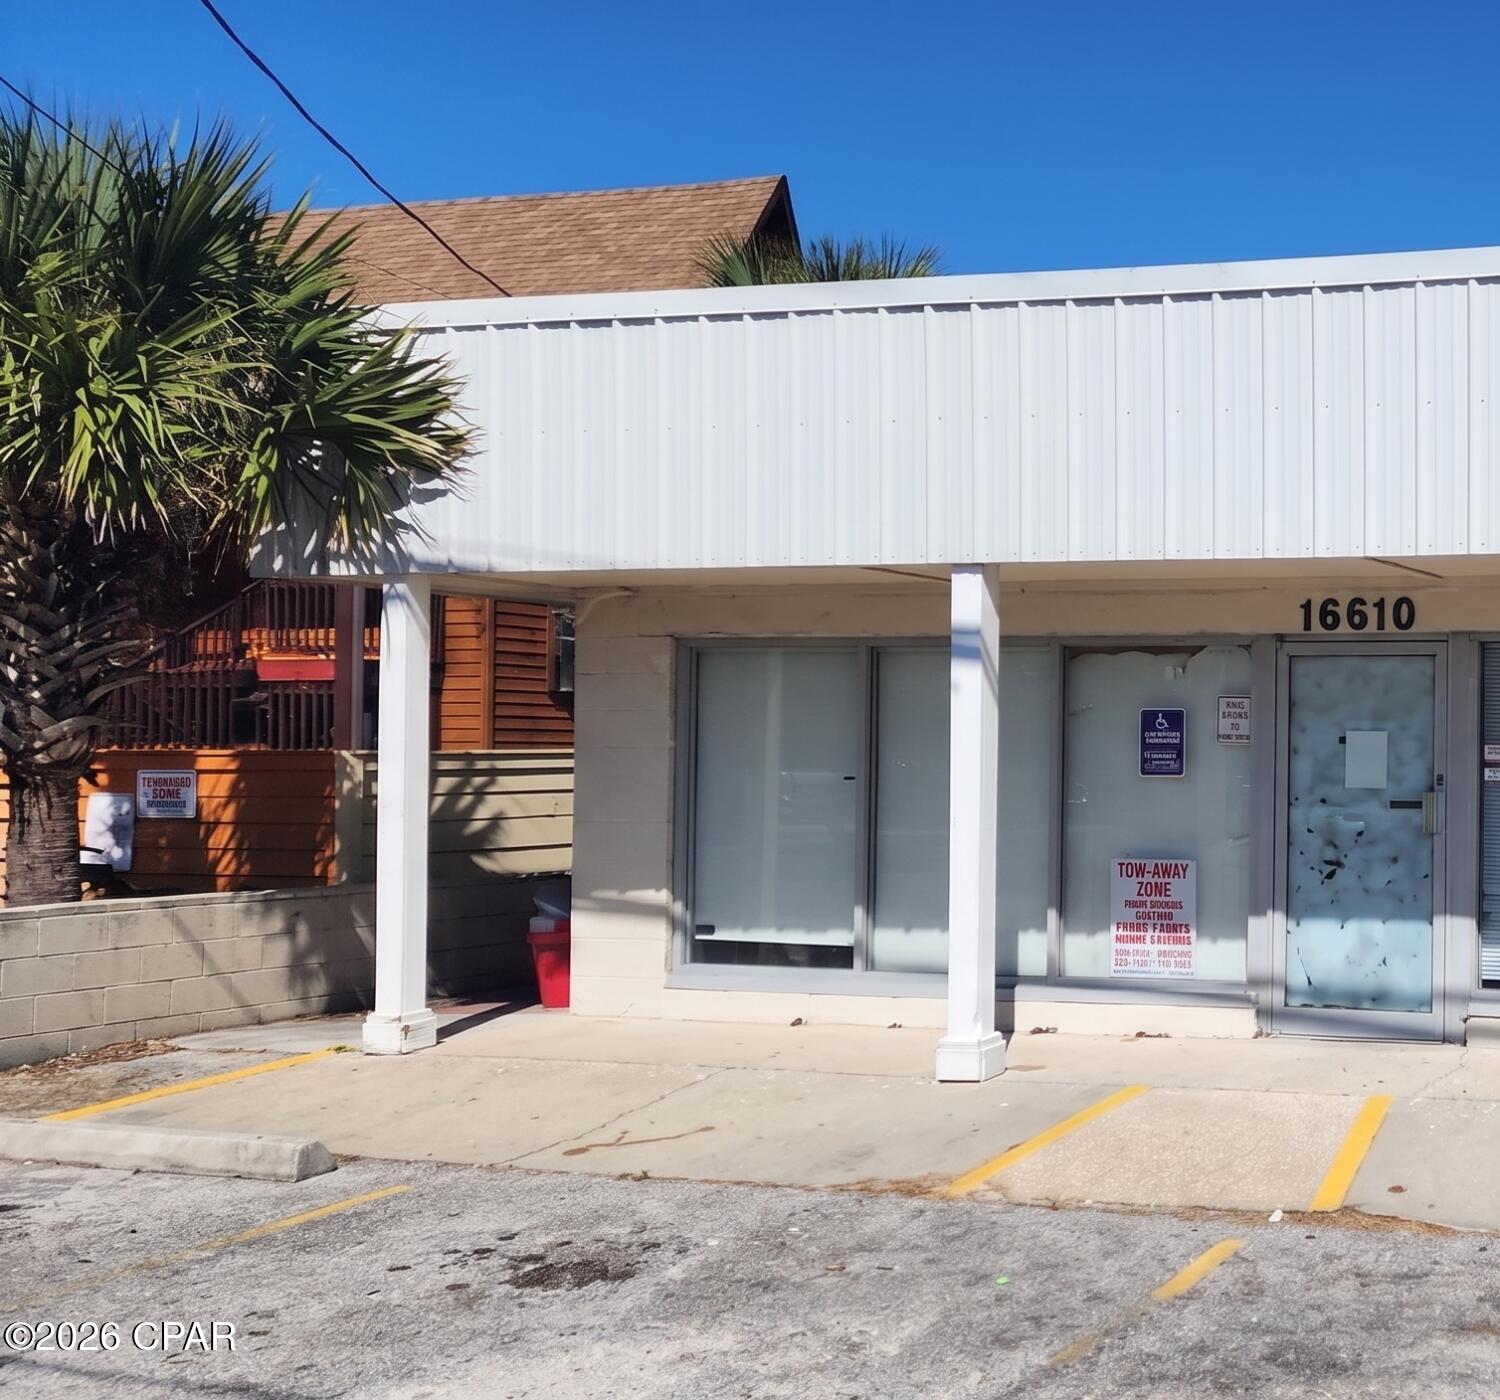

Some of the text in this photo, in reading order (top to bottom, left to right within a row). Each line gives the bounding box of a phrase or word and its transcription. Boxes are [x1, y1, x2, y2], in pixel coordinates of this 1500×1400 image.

[1299, 596, 1416, 632] 16610
[1117, 862, 1189, 880] TOW-AWAY
[1136, 881, 1172, 898] ZONE
